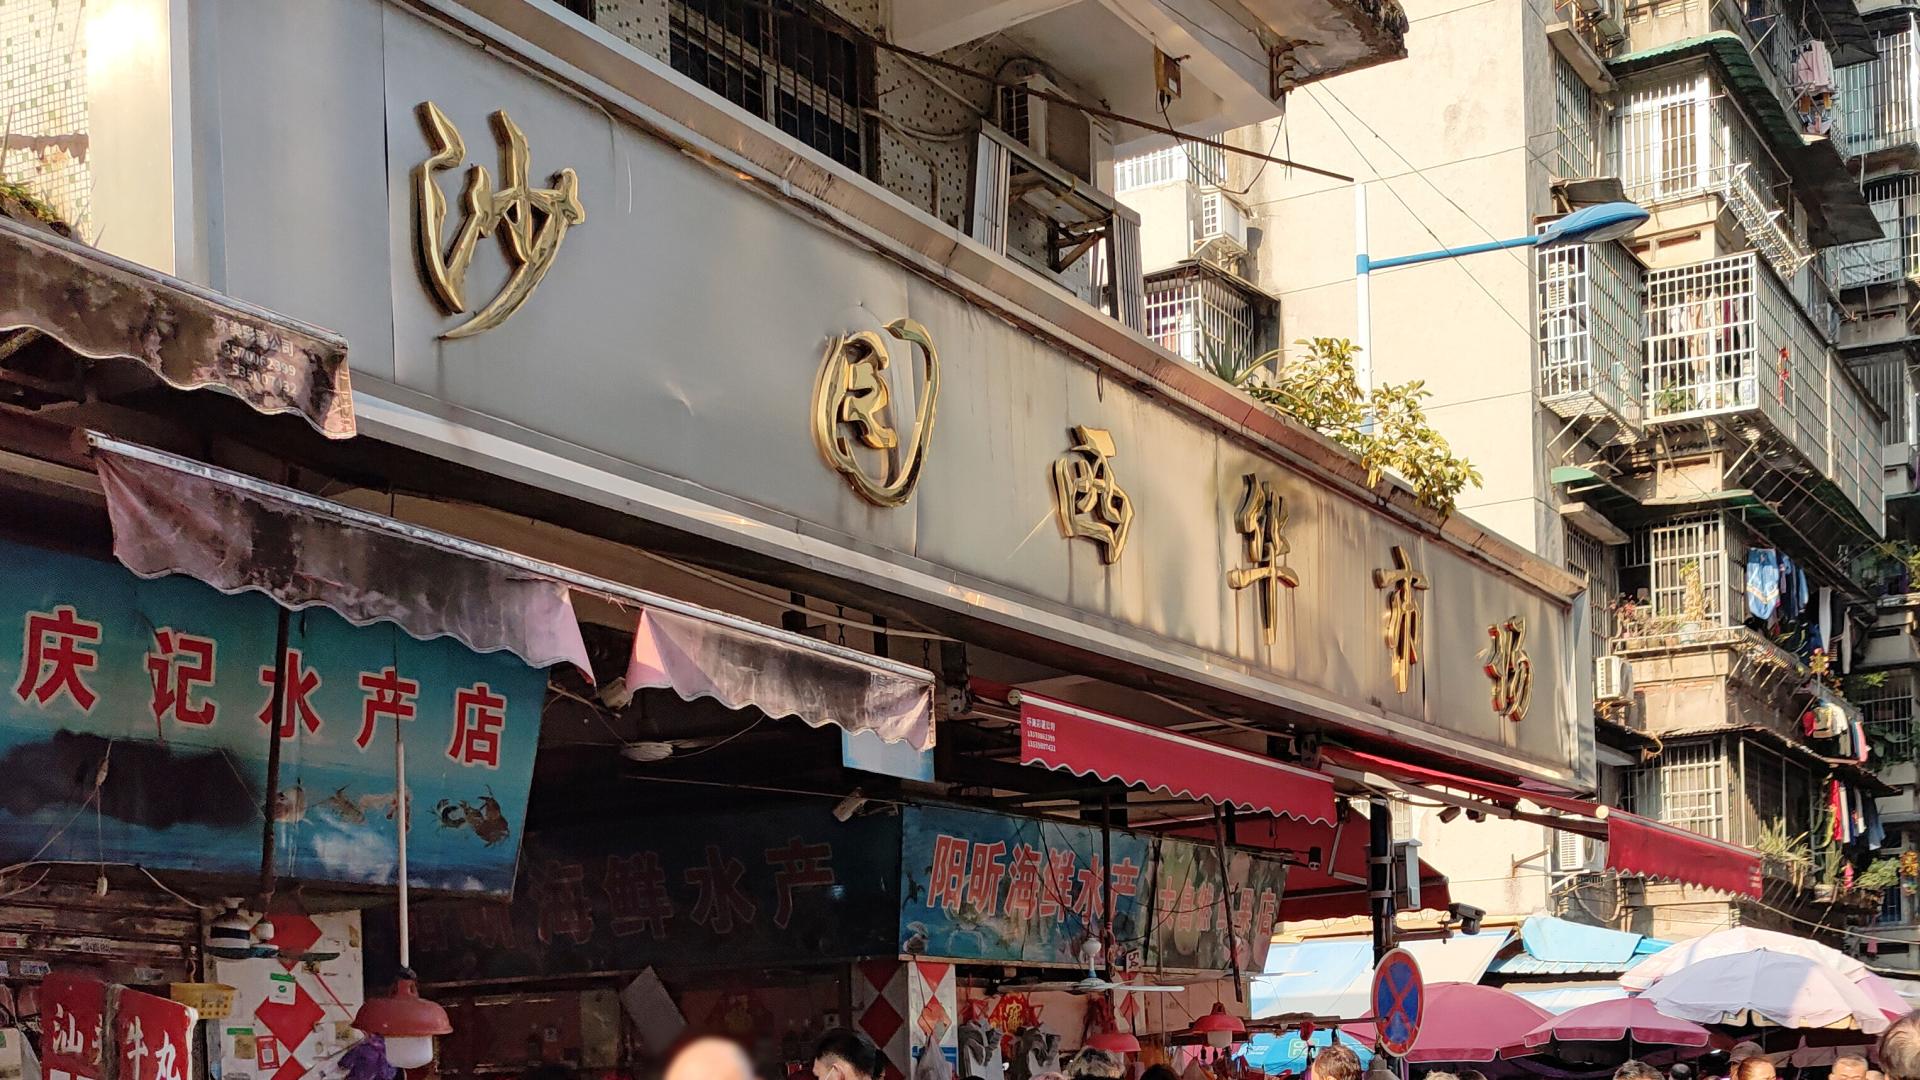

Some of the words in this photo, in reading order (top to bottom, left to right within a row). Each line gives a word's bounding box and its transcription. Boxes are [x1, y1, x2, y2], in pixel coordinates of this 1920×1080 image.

[16, 605, 508, 769] 庆记水产店
[410, 835, 836, 951] 海鲜水产
[927, 834, 1140, 924] 阳昕海鲜水产
